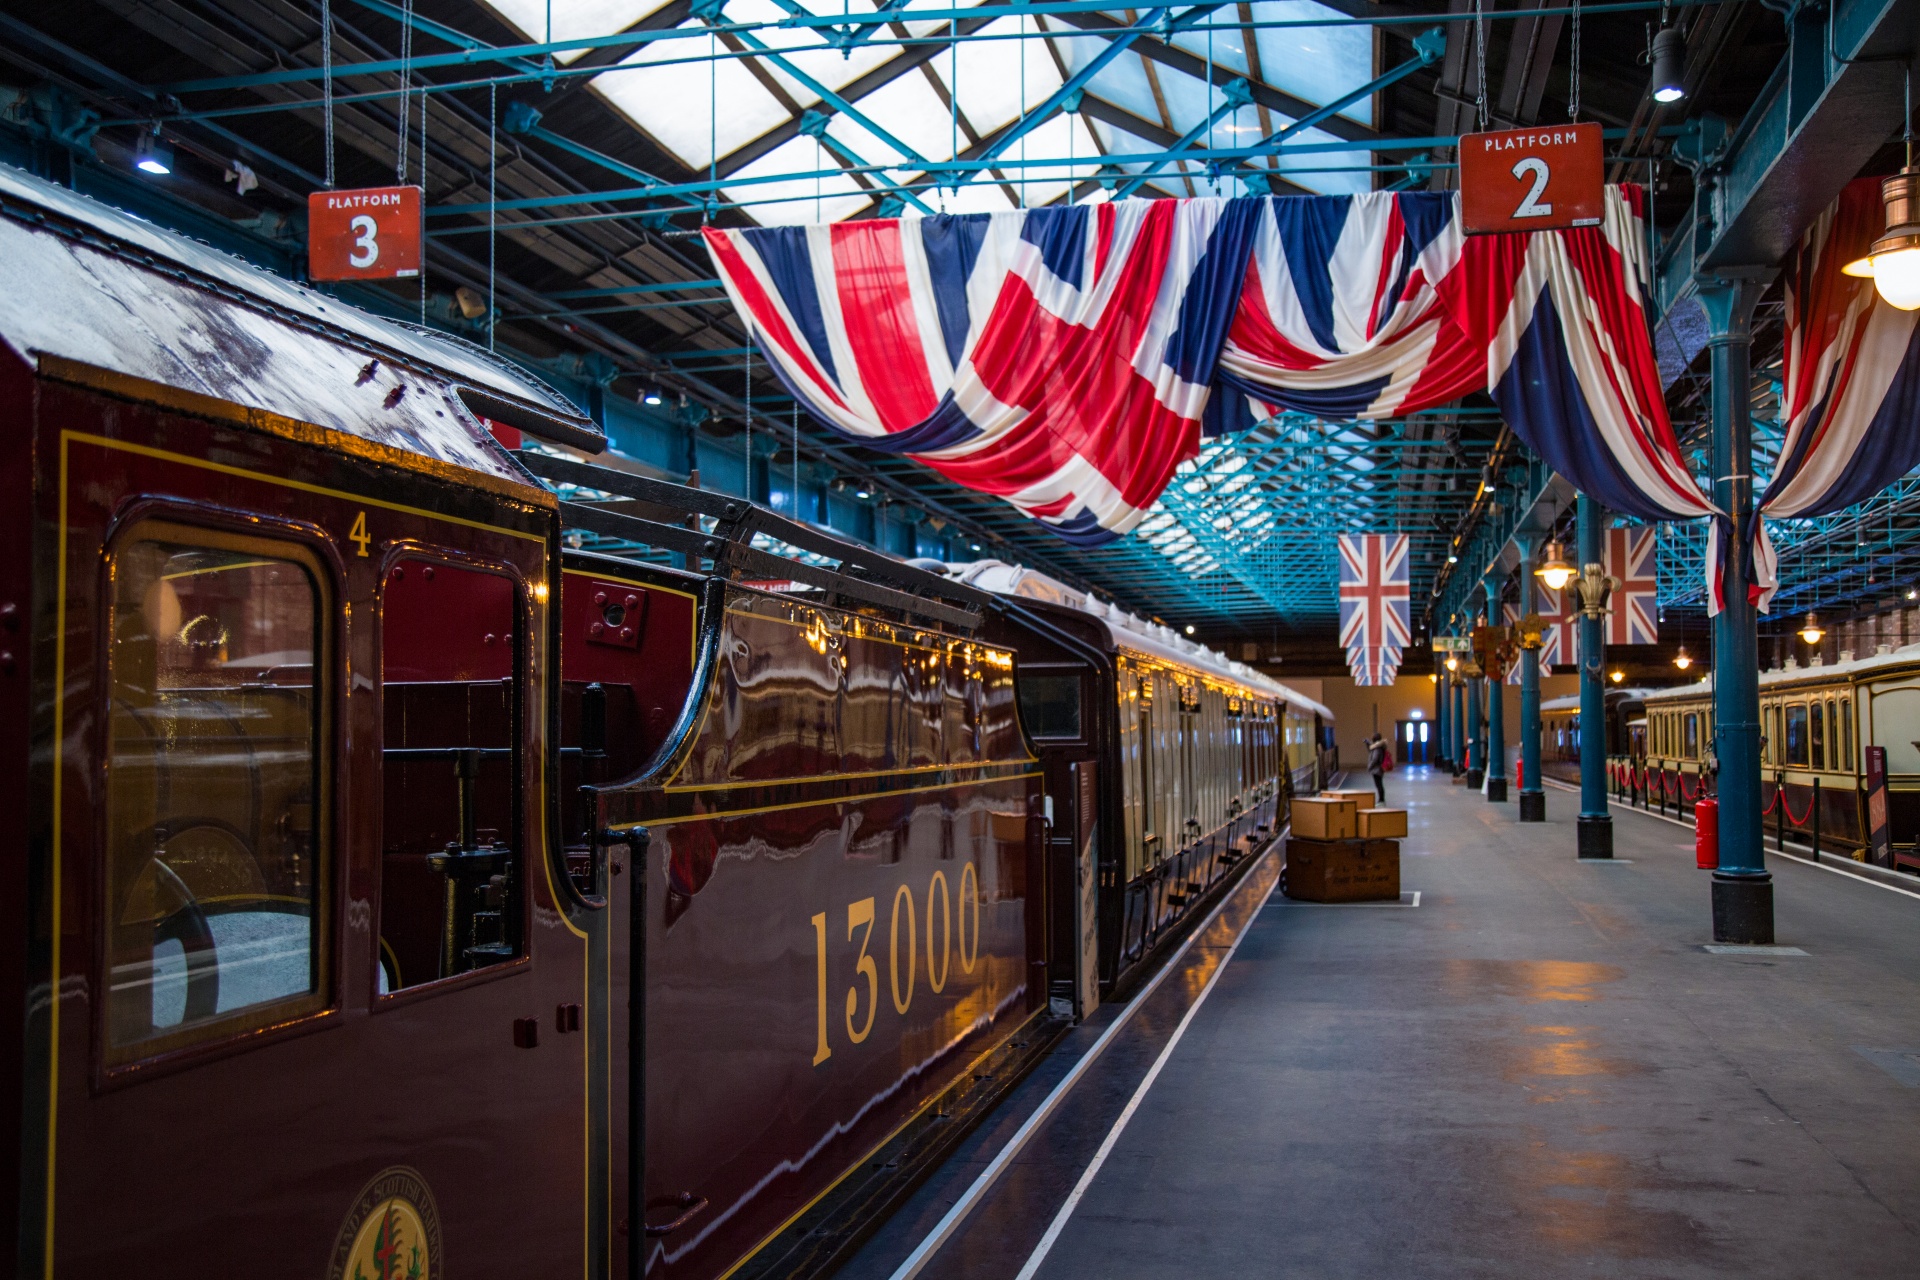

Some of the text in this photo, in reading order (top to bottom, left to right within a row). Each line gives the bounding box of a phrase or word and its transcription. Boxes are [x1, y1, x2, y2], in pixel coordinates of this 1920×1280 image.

[1485, 131, 1577, 151] PLATFORM
[328, 194, 401, 209] PLATFORM
[1511, 156, 1552, 219] 2
[350, 214, 379, 268] 3
[349, 511, 371, 557] 4
[811, 861, 980, 1067] 13000
[374, 1176, 421, 1203] SCOTTISH
[419, 1195, 439, 1265] RAILWAY
